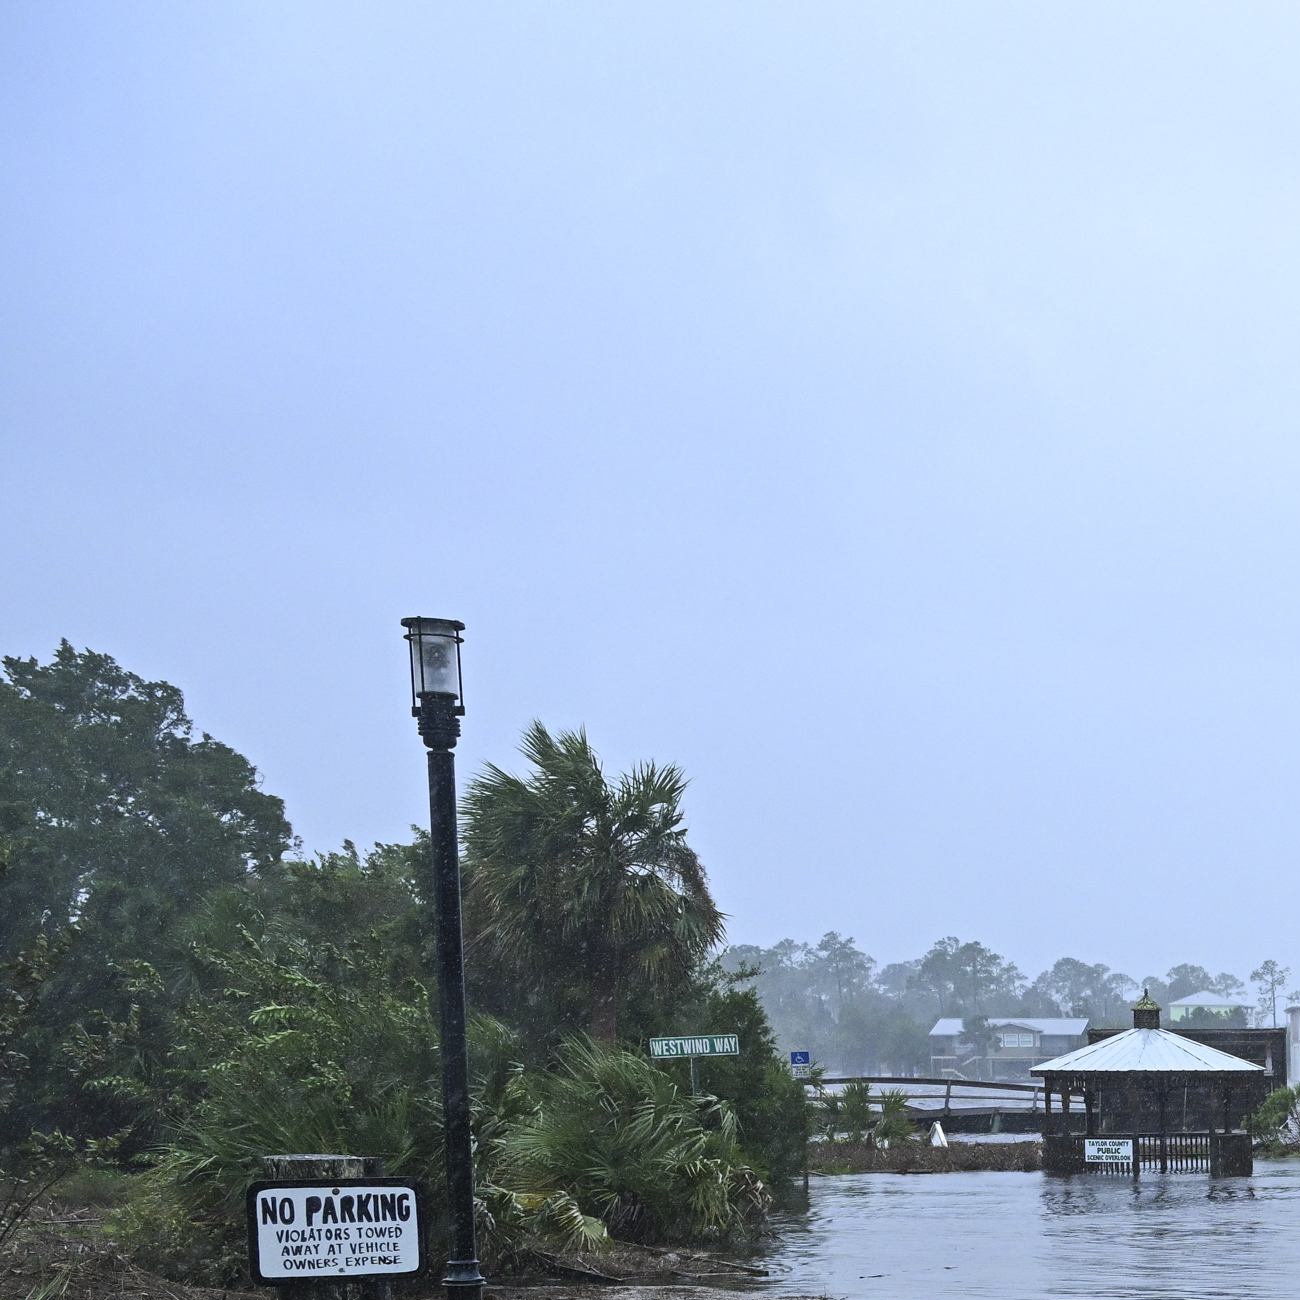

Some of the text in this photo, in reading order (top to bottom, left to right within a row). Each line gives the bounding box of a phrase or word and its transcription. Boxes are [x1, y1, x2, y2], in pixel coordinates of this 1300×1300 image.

[652, 1038, 736, 1055] WESTWIND WAY
[261, 1193, 411, 1227] NO PARKING
[276, 1226, 402, 1243] VIOLATORS TOWED
[281, 1242, 400, 1256] AWAY AT VEHICLE
[283, 1255, 402, 1270] OWNERS EXPENSE
